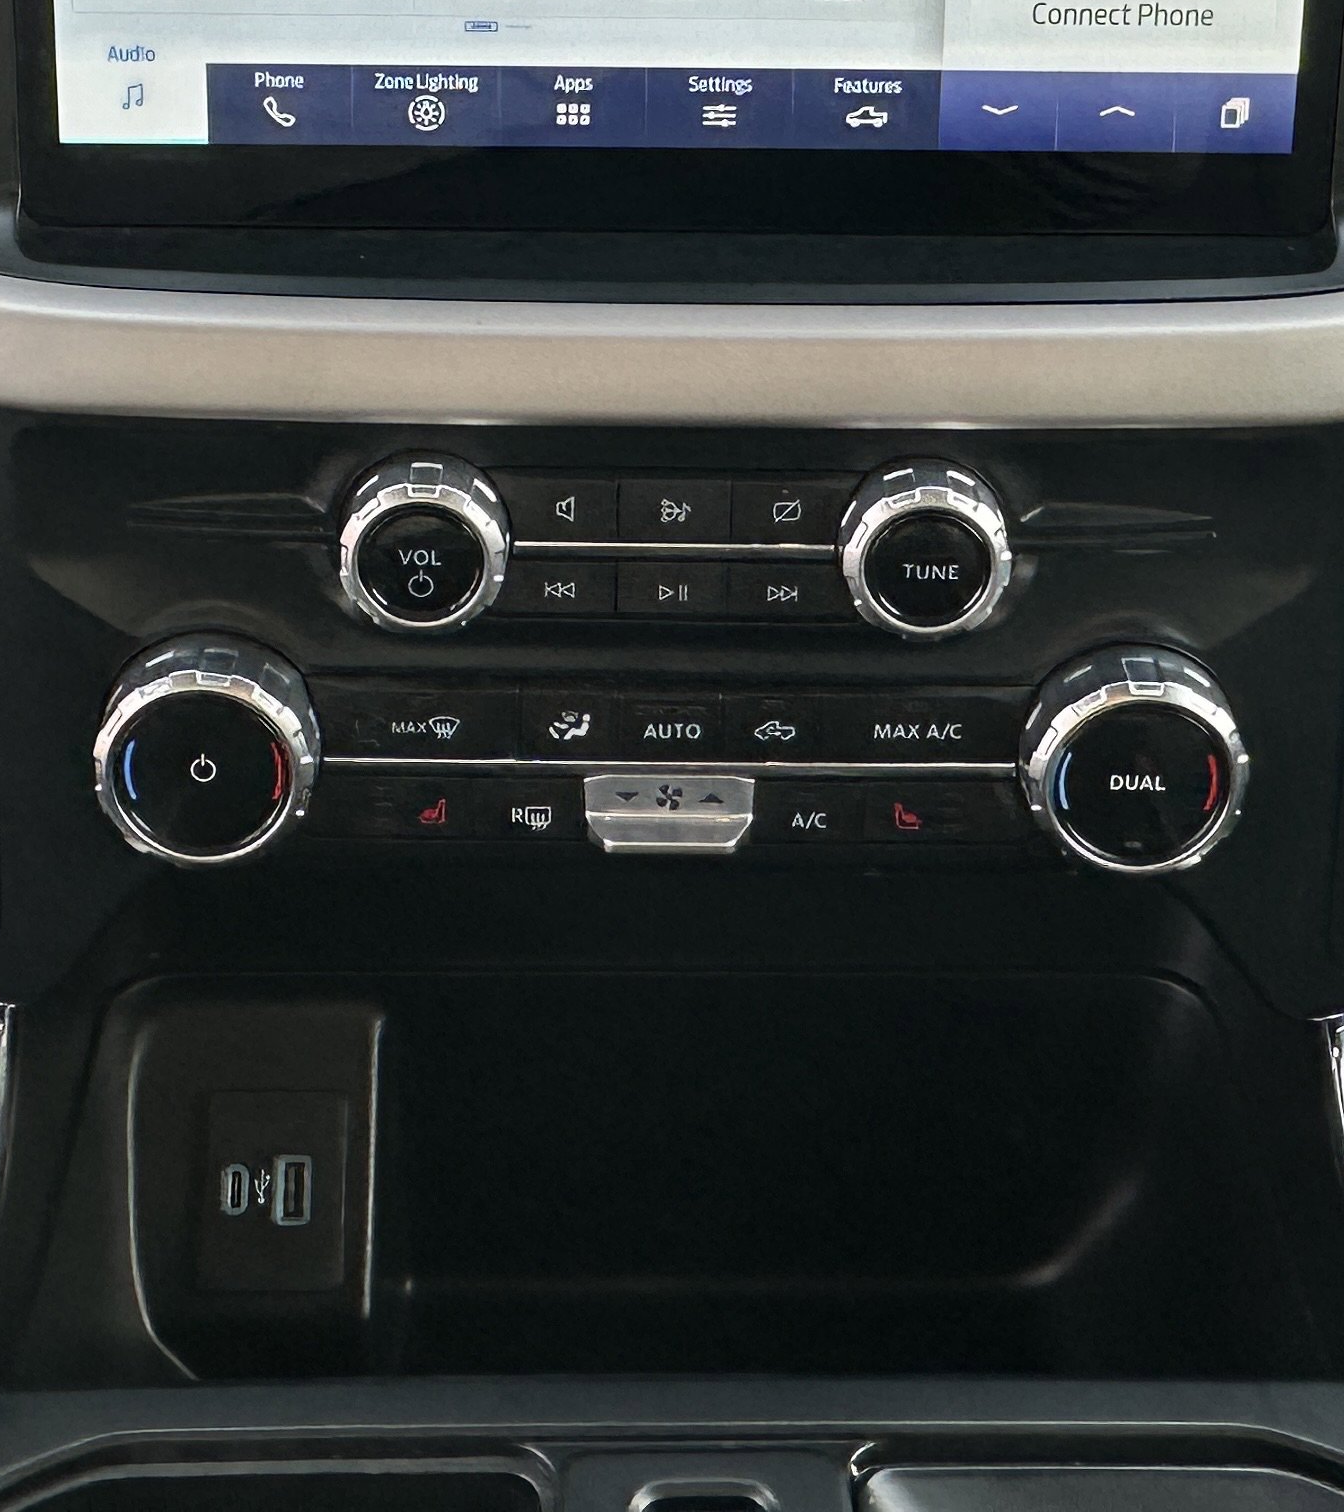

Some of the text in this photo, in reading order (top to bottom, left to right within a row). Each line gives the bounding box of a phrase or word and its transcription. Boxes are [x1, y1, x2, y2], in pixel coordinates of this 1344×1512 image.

[1032, 2, 1214, 27] Connect Phone
[107, 45, 156, 62] Audio
[254, 71, 305, 89] Phone
[374, 72, 479, 93] Zone Lighting
[553, 74, 594, 94] Apps
[688, 75, 753, 96] Settings
[833, 77, 903, 94] Features
[398, 549, 442, 566] VOL
[902, 563, 959, 580] TUNE
[391, 721, 427, 734] MAX
[643, 723, 702, 739] AUTO
[873, 723, 962, 740] MAX A/C
[1109, 774, 1166, 792] DUAL
[511, 807, 523, 823] R
[791, 811, 827, 830] A/C
